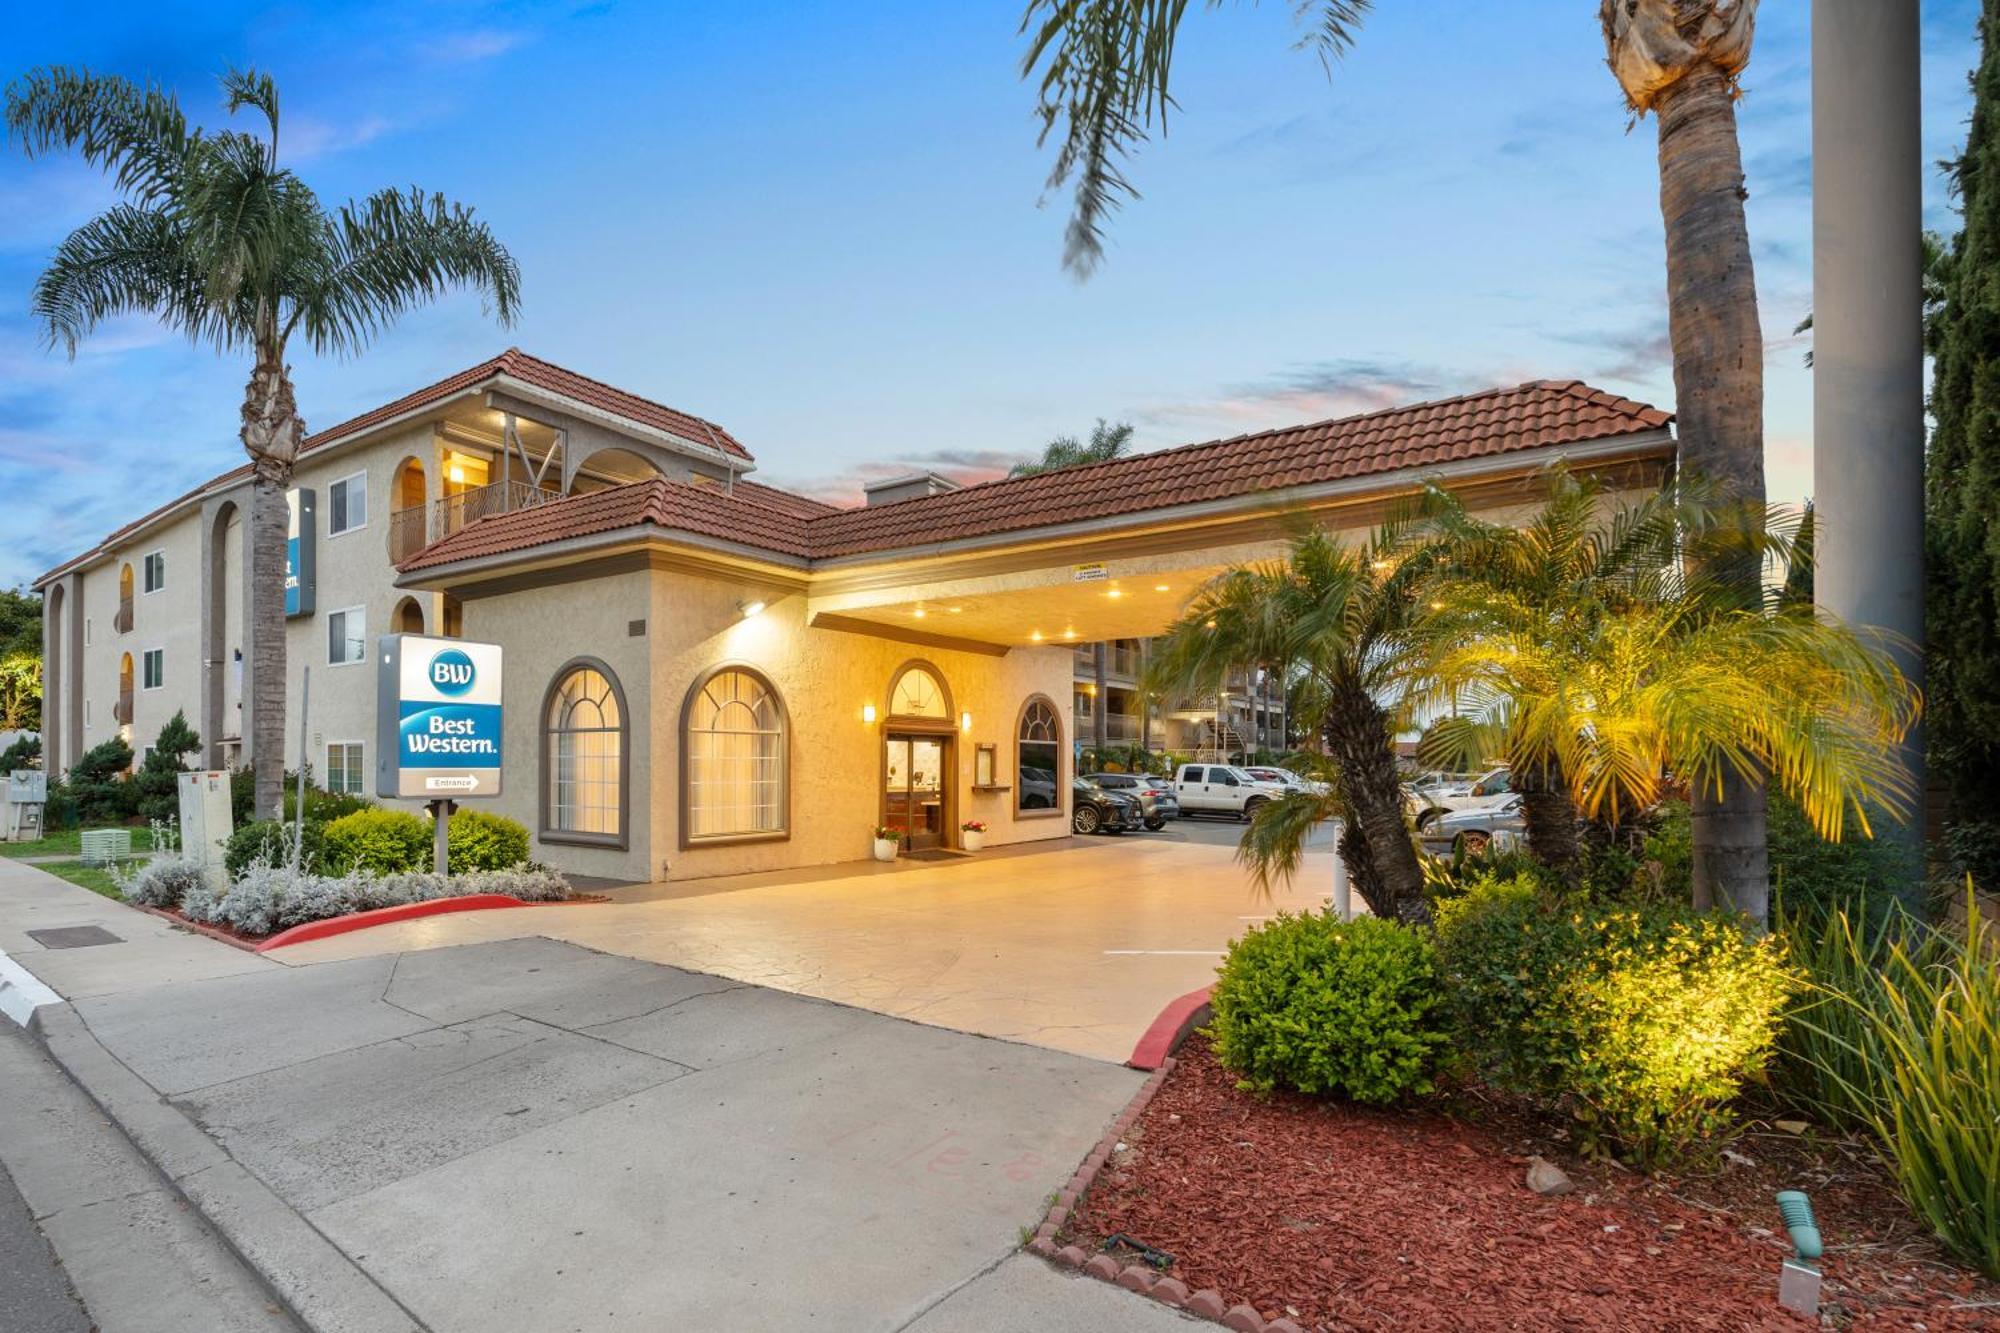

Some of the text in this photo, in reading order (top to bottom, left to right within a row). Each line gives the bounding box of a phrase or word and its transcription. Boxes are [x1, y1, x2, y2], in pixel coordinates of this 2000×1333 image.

[434, 663, 471, 684] BW
[429, 716, 475, 734] Best
[434, 779, 472, 787] Entrance
